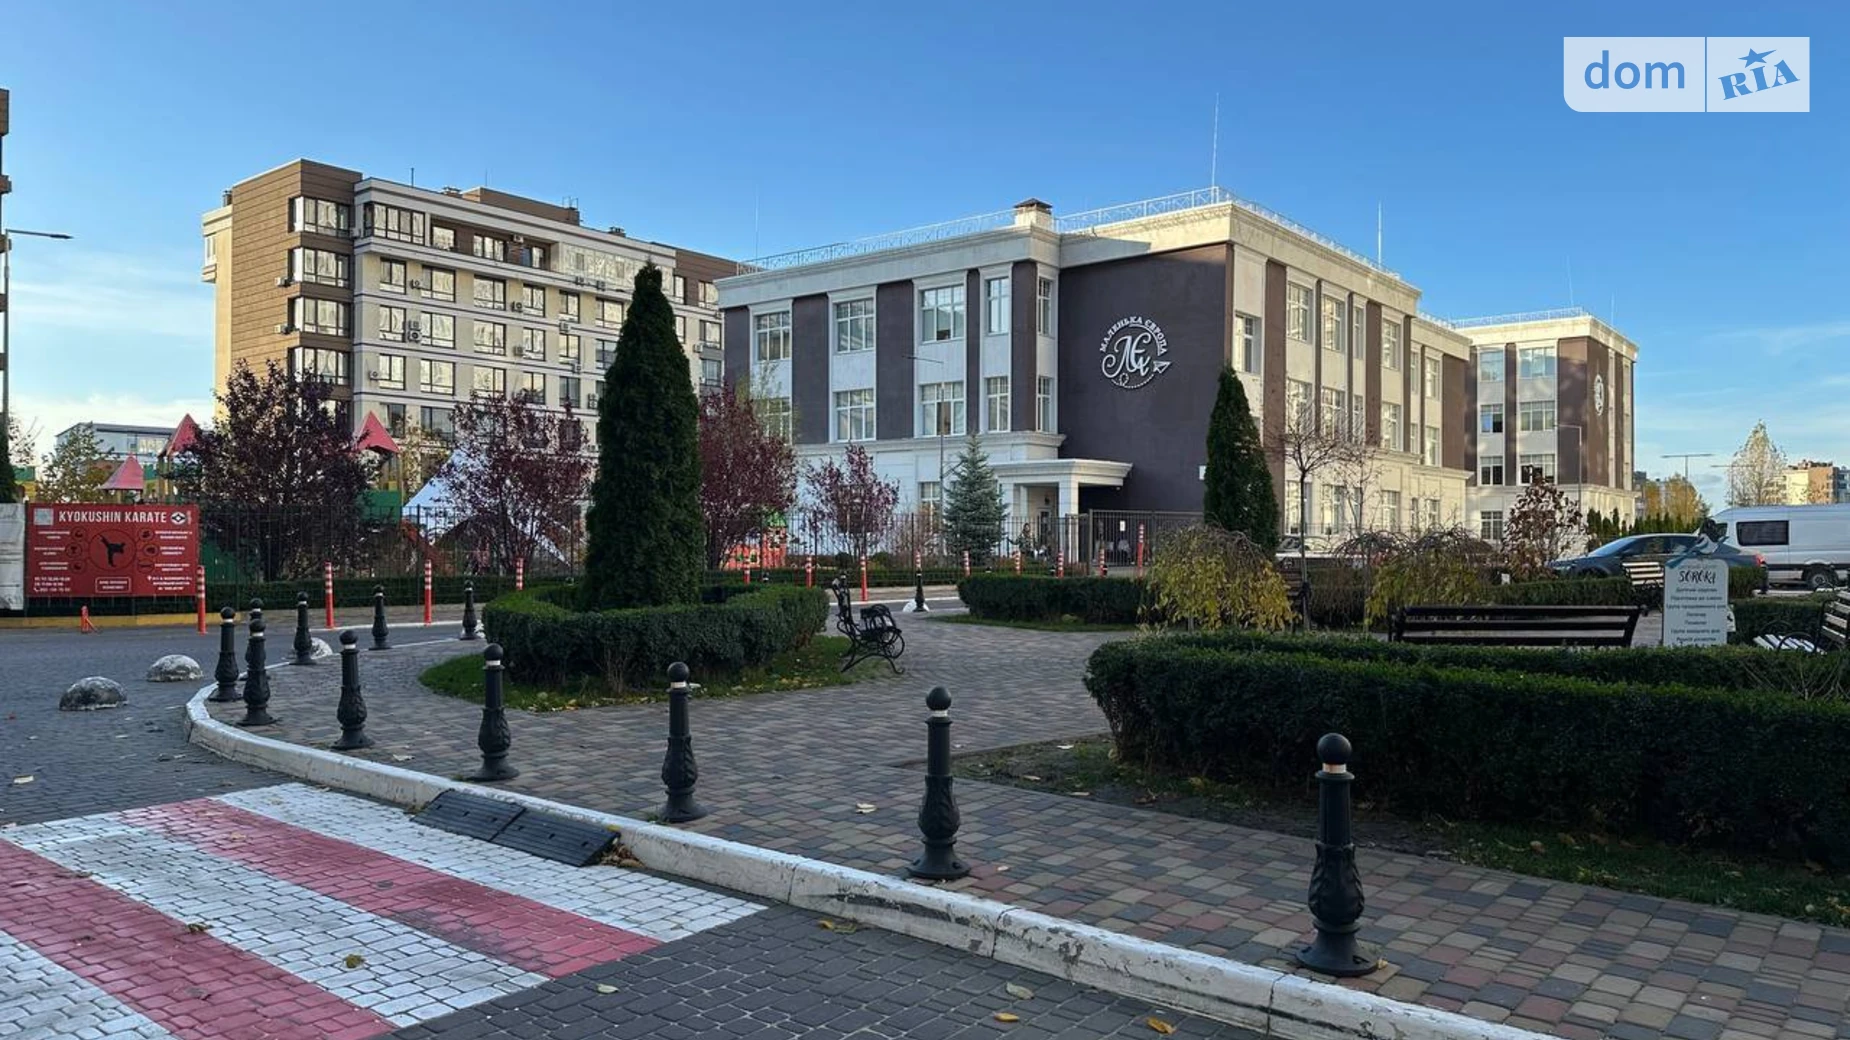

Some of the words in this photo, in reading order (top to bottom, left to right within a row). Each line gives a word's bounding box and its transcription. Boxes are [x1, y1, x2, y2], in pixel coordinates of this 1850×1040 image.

[1099, 316, 1143, 353] МАЛЕНЬКА
[58, 511, 121, 523] KYOKUSHIN
[124, 511, 167, 523] KARATE
